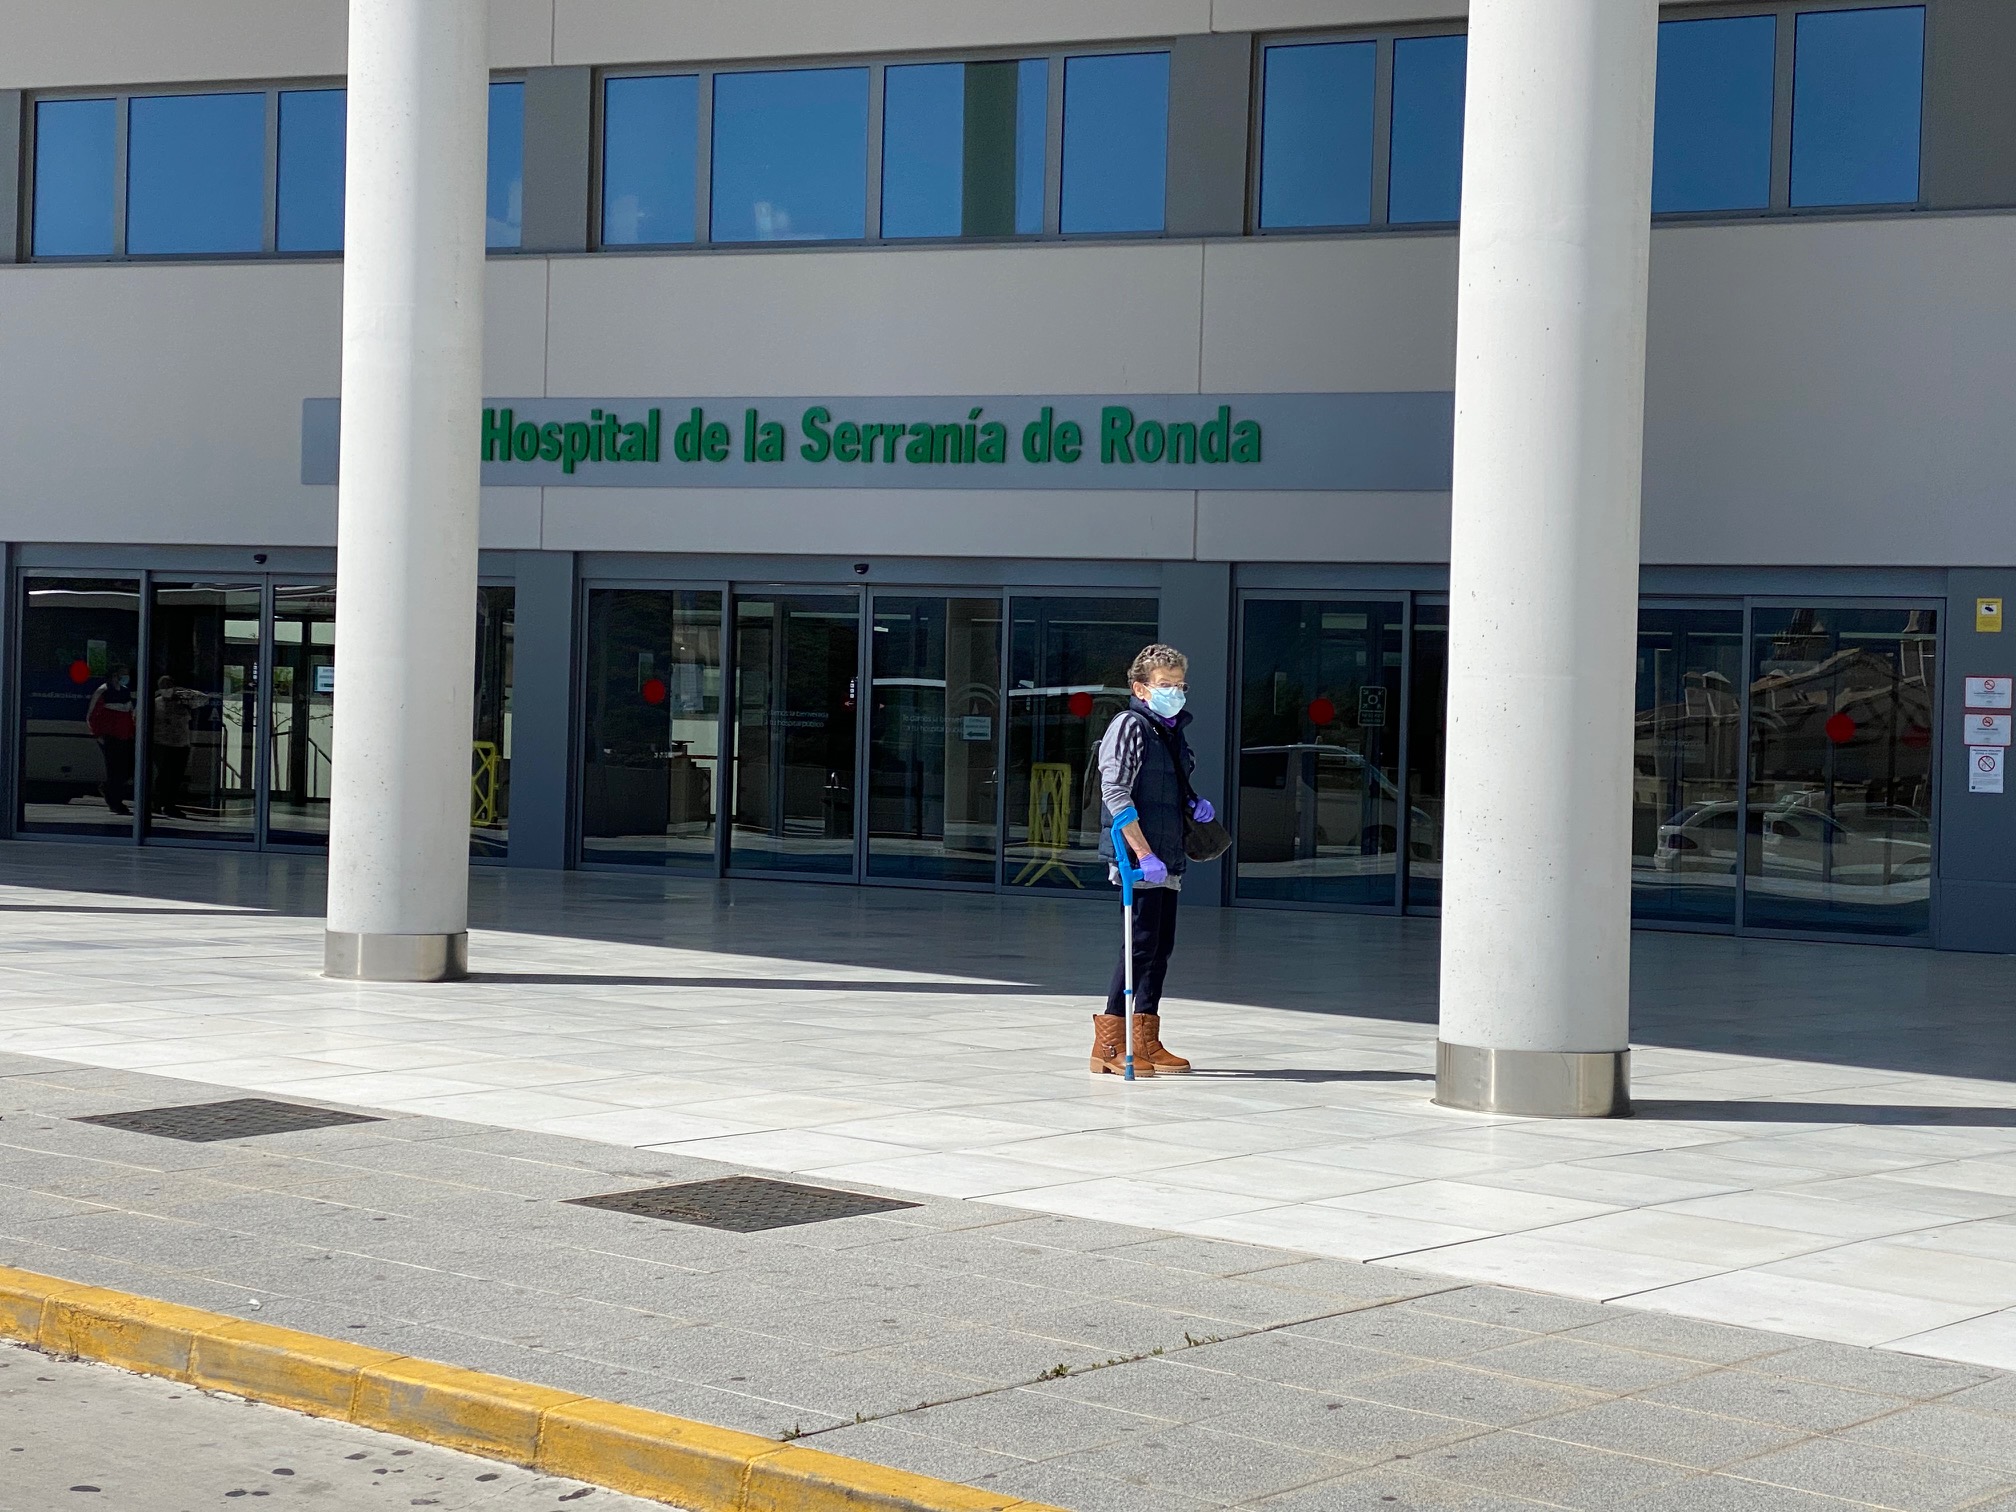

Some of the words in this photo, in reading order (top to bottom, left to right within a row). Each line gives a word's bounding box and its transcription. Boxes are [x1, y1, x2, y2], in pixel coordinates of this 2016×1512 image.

[481, 408, 661, 475] Hospital
[674, 407, 730, 463] de
[743, 408, 784, 463] la
[800, 405, 1006, 465] Serranía
[1022, 406, 1082, 464] de
[1100, 405, 1261, 465] Ronda
